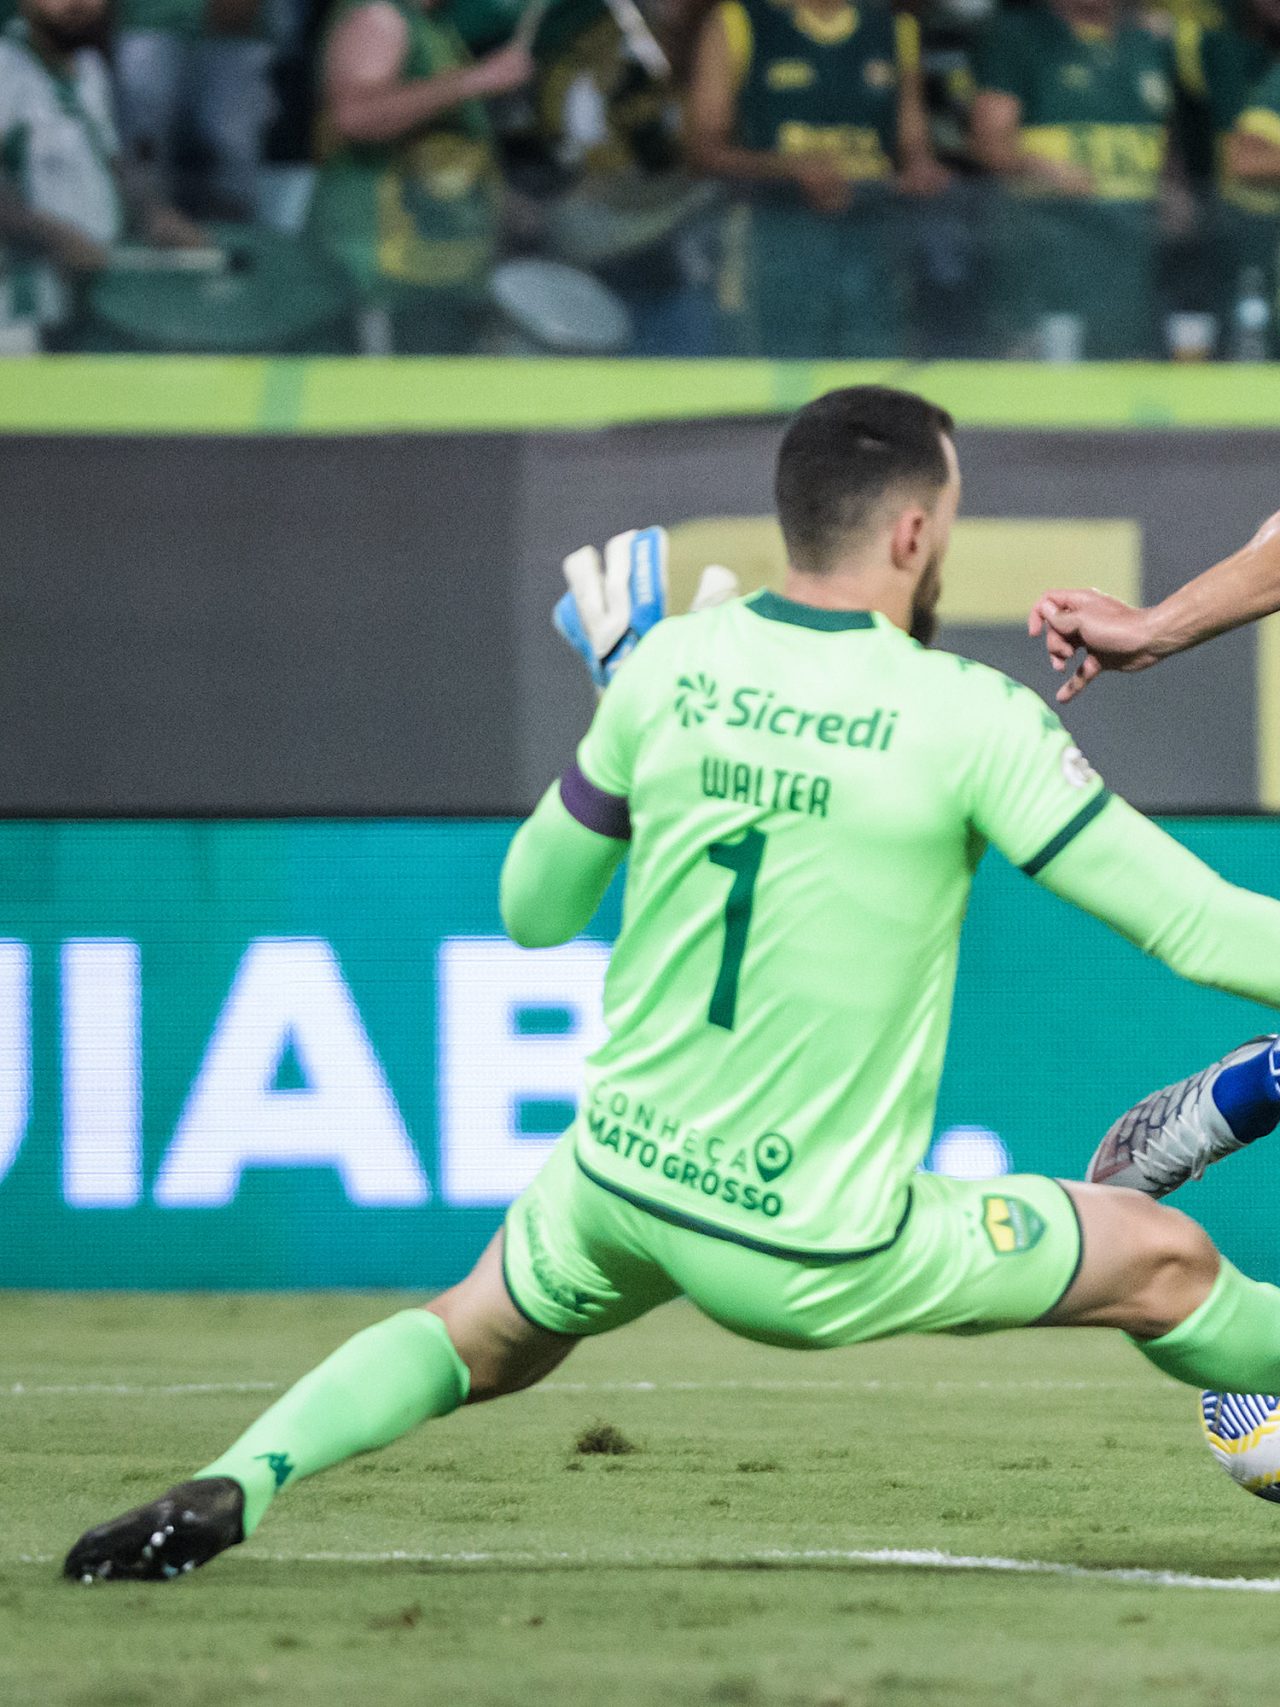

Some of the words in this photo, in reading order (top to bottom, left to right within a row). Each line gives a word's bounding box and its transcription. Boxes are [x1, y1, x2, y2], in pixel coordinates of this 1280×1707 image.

[726, 686, 899, 751] Sicredi
[703, 757, 833, 818] WALTER
[708, 825, 769, 1031] 1
[588, 1107, 658, 1168] MATO
[662, 1153, 784, 1218] GROSSO
